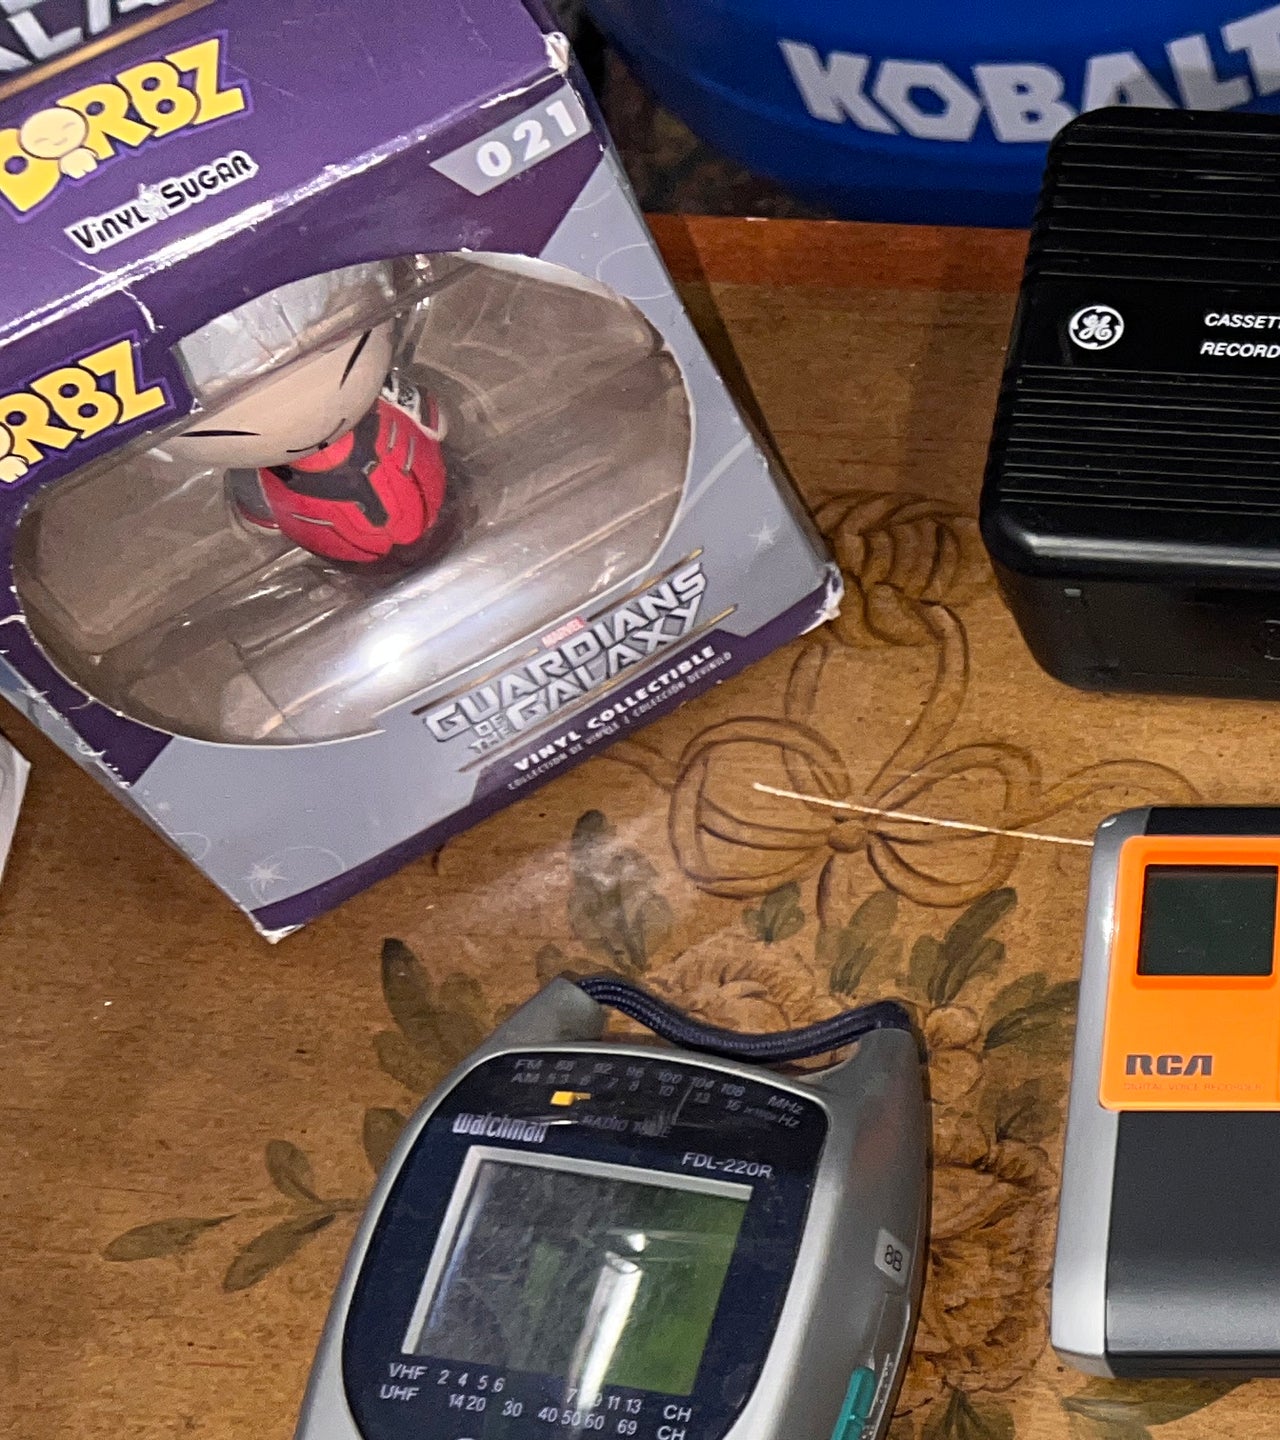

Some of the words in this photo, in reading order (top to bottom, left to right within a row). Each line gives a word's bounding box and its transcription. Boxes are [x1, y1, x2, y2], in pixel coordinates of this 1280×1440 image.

[476, 102, 578, 178] 021
[0, 338, 168, 464] RBZ
[424, 562, 707, 742] GUARDIANS
[507, 598, 706, 731] GALAXY
[514, 731, 581, 772] VINYL
[587, 645, 716, 729] COLLECTIBLE
[512, 1073, 540, 1084] AM
[515, 1059, 541, 1070] FM
[720, 1082, 745, 1097] 108
[1125, 1054, 1213, 1076] RCA
[682, 1152, 773, 1179] FDL-220R
[379, 1384, 419, 1401] UHF
[449, 1393, 463, 1408] 14
[465, 1397, 486, 1412] 20
[502, 1400, 523, 1417] 30
[538, 1406, 558, 1422] 40
[562, 1409, 581, 1427] 50
[585, 1413, 605, 1430] 60
[617, 1418, 638, 1435] 69
[388, 1362, 428, 1382] VHF
[438, 1369, 450, 1385] 2
[457, 1372, 468, 1387] 4
[477, 1375, 488, 1390] 5
[492, 1378, 505, 1393] 6
[566, 1388, 579, 1404] 7
[608, 1395, 620, 1410] 11
[626, 1398, 642, 1414] 13
[663, 1404, 692, 1422] CH
